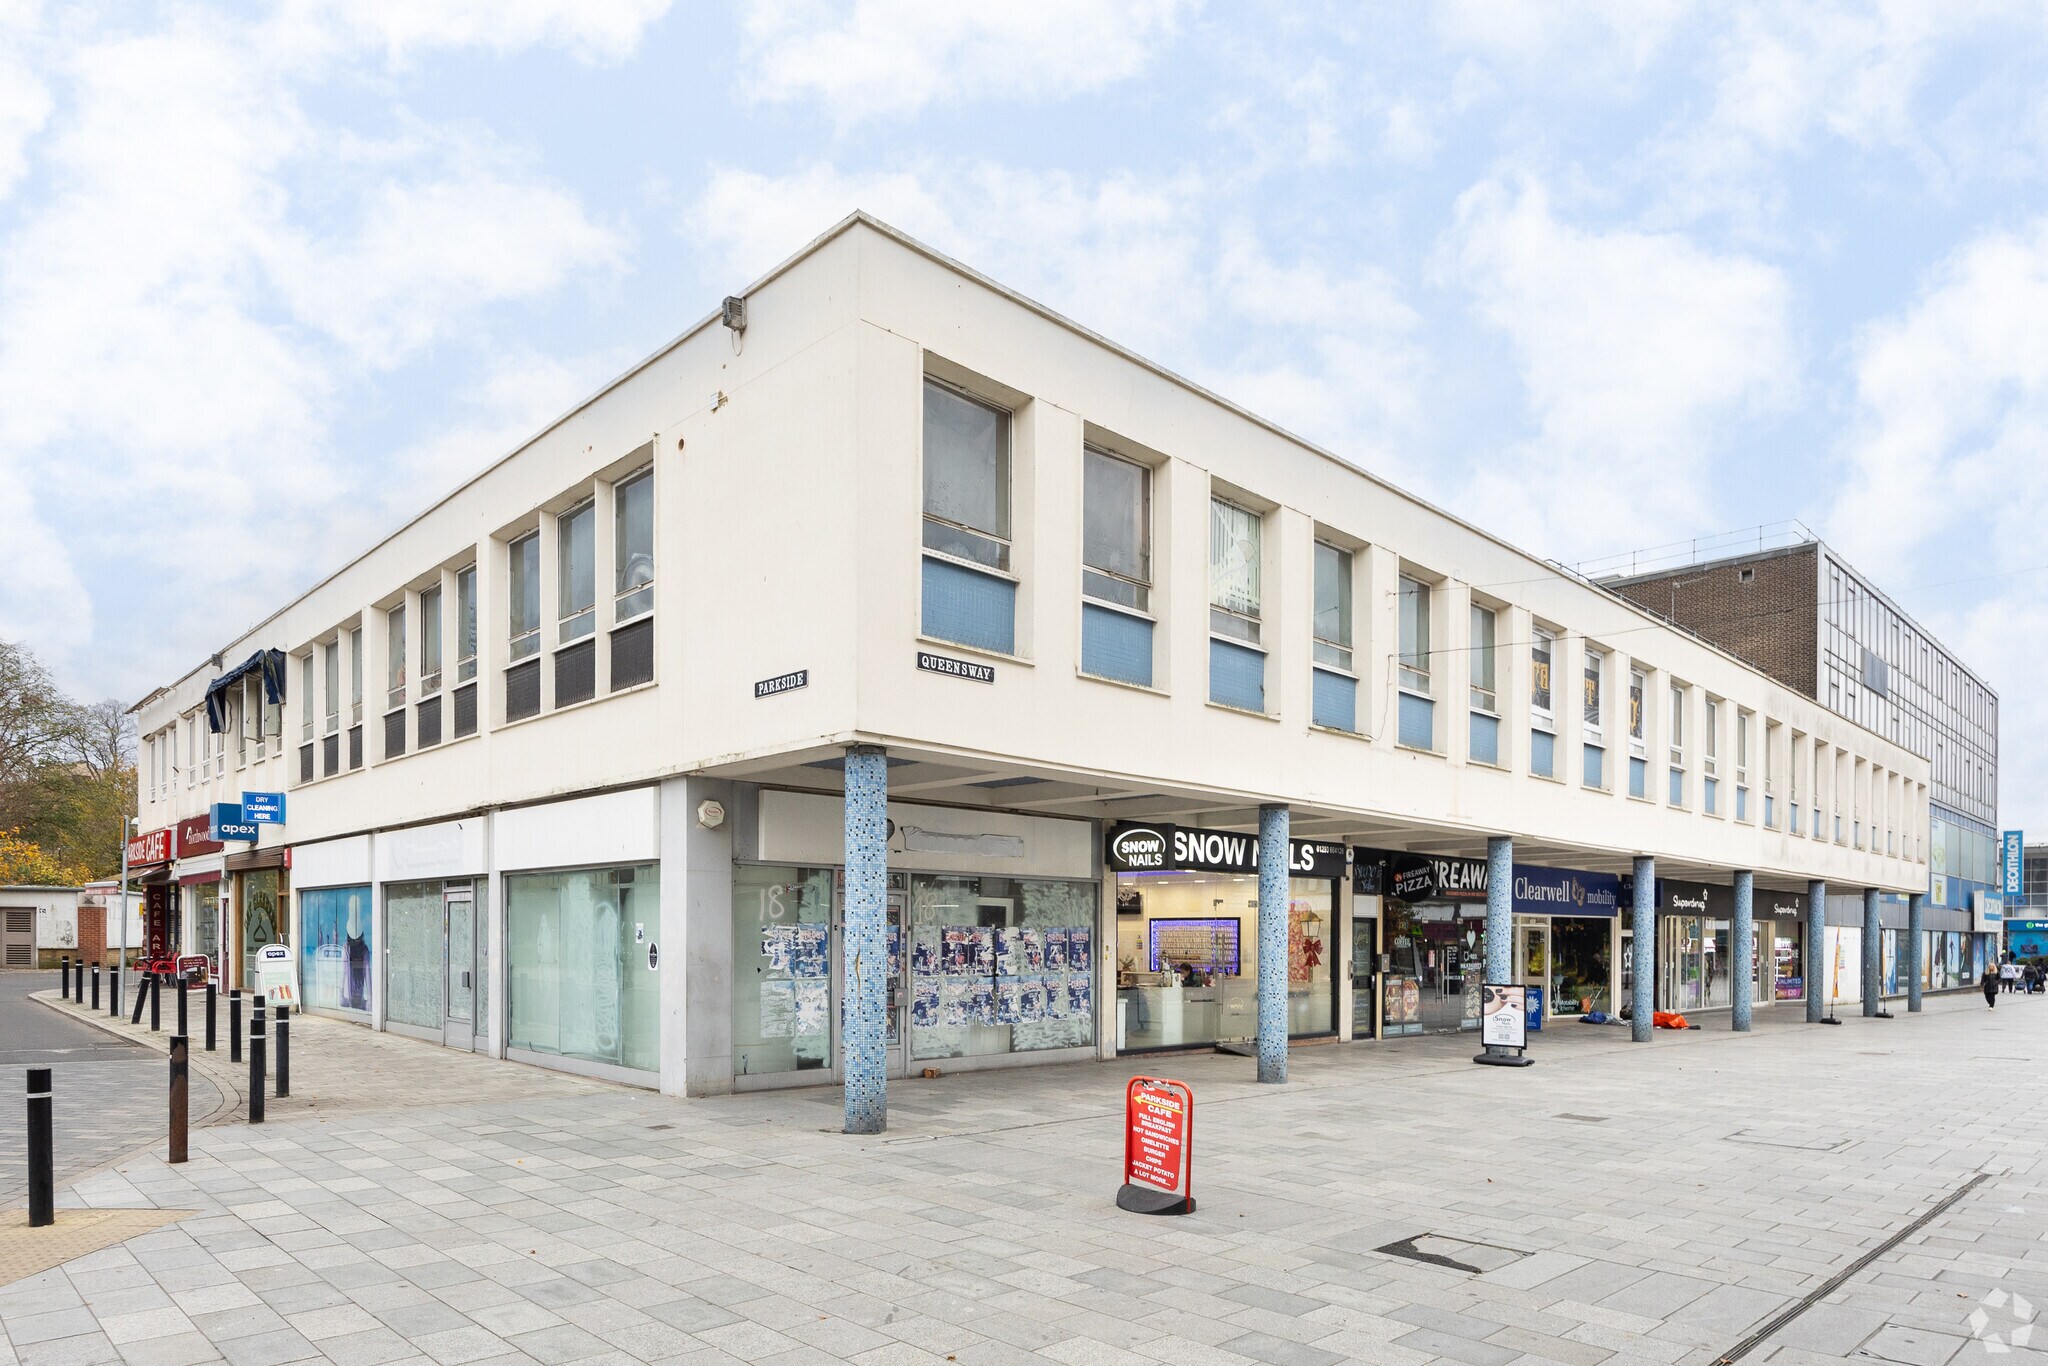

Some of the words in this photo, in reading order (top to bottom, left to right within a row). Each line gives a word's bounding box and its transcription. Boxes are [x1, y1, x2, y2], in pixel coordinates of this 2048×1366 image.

[921, 654, 992, 682] QUEENSWAY
[758, 673, 804, 696] PARKSIDE
[246, 804, 278, 812] CLEANING
[221, 825, 255, 834] apex
[128, 840, 145, 861] ARKSIDE
[146, 832, 165, 862] CAFE
[1121, 839, 1160, 854] SNOW
[1175, 831, 1247, 866] SNOW
[1128, 853, 1163, 867] NAILS
[2007, 834, 2019, 893] DECATHLON
[1402, 866, 1431, 880] FIREAWAY
[1396, 875, 1433, 895] PIZZA
[1515, 877, 1570, 902] Clearwell
[1587, 889, 1617, 909] mobility
[152, 894, 162, 927] CAFE
[1672, 894, 1706, 912] Superdrug
[1774, 903, 1798, 917] Superdrug
[1140, 1092, 1180, 1110] PARKSIDE
[1148, 1105, 1172, 1118] CAFE
[1138, 1112, 1152, 1122] FULL
[1152, 1116, 1176, 1129] ENGLISH
[1141, 1120, 1172, 1134] BREAKFAST
[1132, 1126, 1144, 1134] HOT
[1144, 1129, 1180, 1146] SANDWICHES
[1141, 1137, 1170, 1151] OMELETTE
[1144, 1146, 1166, 1158] BURGER
[1132, 1160, 1152, 1170] JACKET
[1154, 1166, 1175, 1178] POTATO
[1146, 1156, 1162, 1166] CHIPS
[1139, 1170, 1150, 1178] LOT
